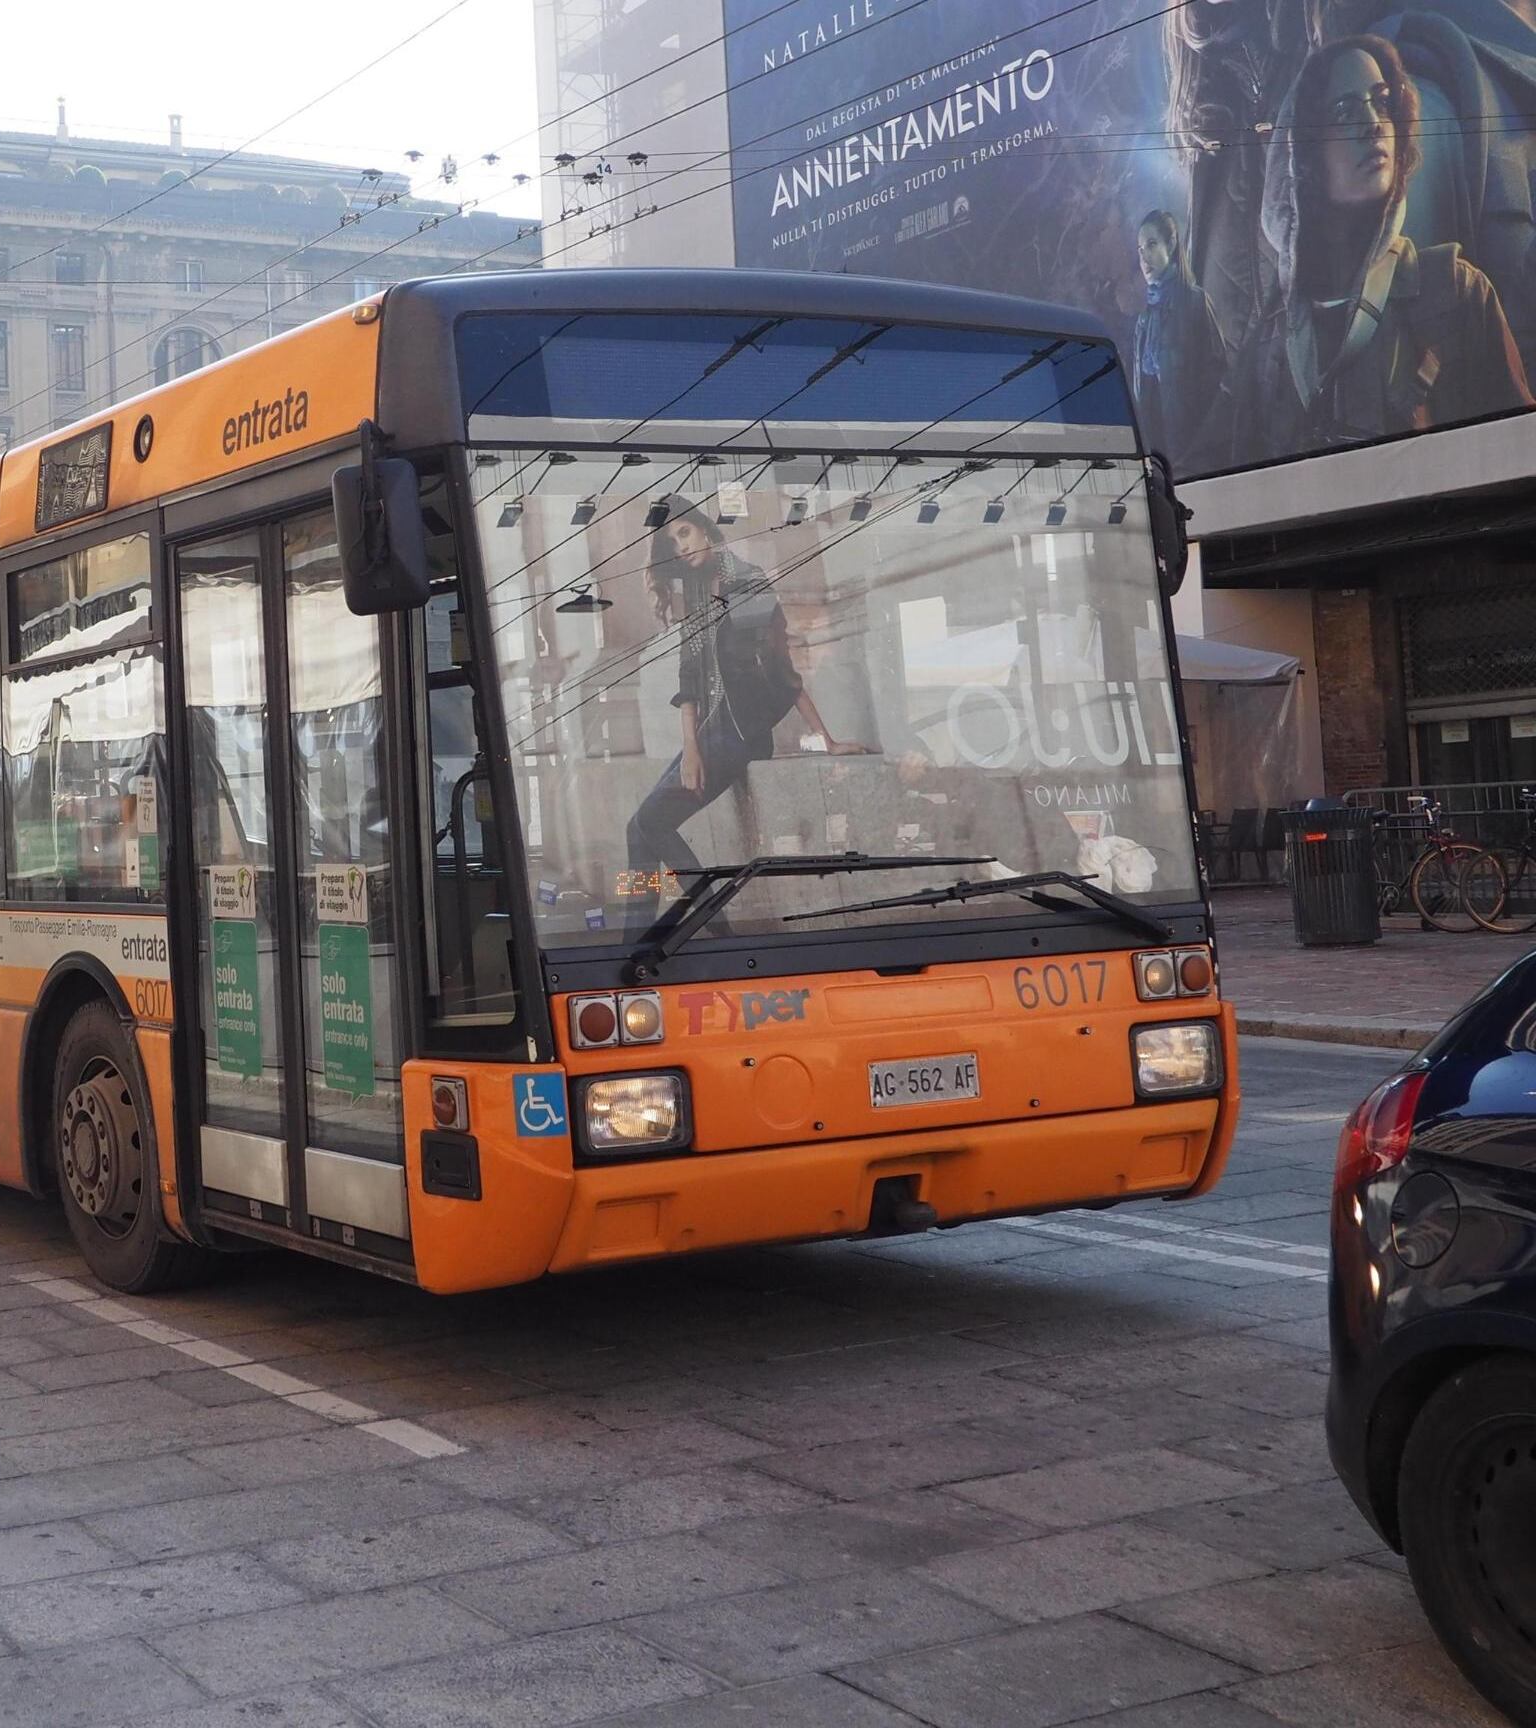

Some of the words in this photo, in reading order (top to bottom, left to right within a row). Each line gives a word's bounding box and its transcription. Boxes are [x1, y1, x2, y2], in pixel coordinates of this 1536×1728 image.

[763, 0, 874, 73] NATALIE
[806, 122, 828, 141] DAL
[832, 97, 881, 129] REGISTA
[886, 85, 901, 103] DI
[771, 49, 1055, 217] ANNIENTAMENTO
[596, 163, 613, 175] 14
[772, 227, 808, 250] NULLA
[811, 217, 823, 233] TI
[828, 186, 900, 226] DISTRUGGE.
[904, 165, 947, 193] TUTTO
[952, 157, 965, 173] TI
[971, 120, 1058, 165] TRASFORMA.
[222, 387, 309, 456] entrata
[214, 873, 235, 884] Prepara
[320, 873, 345, 885] Prepara
[327, 886, 344, 897] titolo
[326, 900, 349, 913] viaggio
[9, 916, 34, 936] Trasporto
[35, 917, 65, 940] Passeggeri
[67, 918, 117, 942] Emilia-Romagna
[121, 932, 167, 963] entrata
[216, 963, 237, 985] solo
[322, 971, 346, 995] solo
[1013, 960, 1108, 1010] 6017
[135, 979, 169, 1017] 6017
[217, 988, 253, 1011] entrata
[323, 998, 364, 1024] entrata
[218, 1017, 243, 1031] entrance
[244, 1018, 256, 1038] only
[325, 1029, 353, 1046] entrance
[354, 1031, 368, 1050] only
[873, 1072, 896, 1098] AG
[908, 1067, 944, 1094] 562
[955, 1063, 975, 1089] AF
